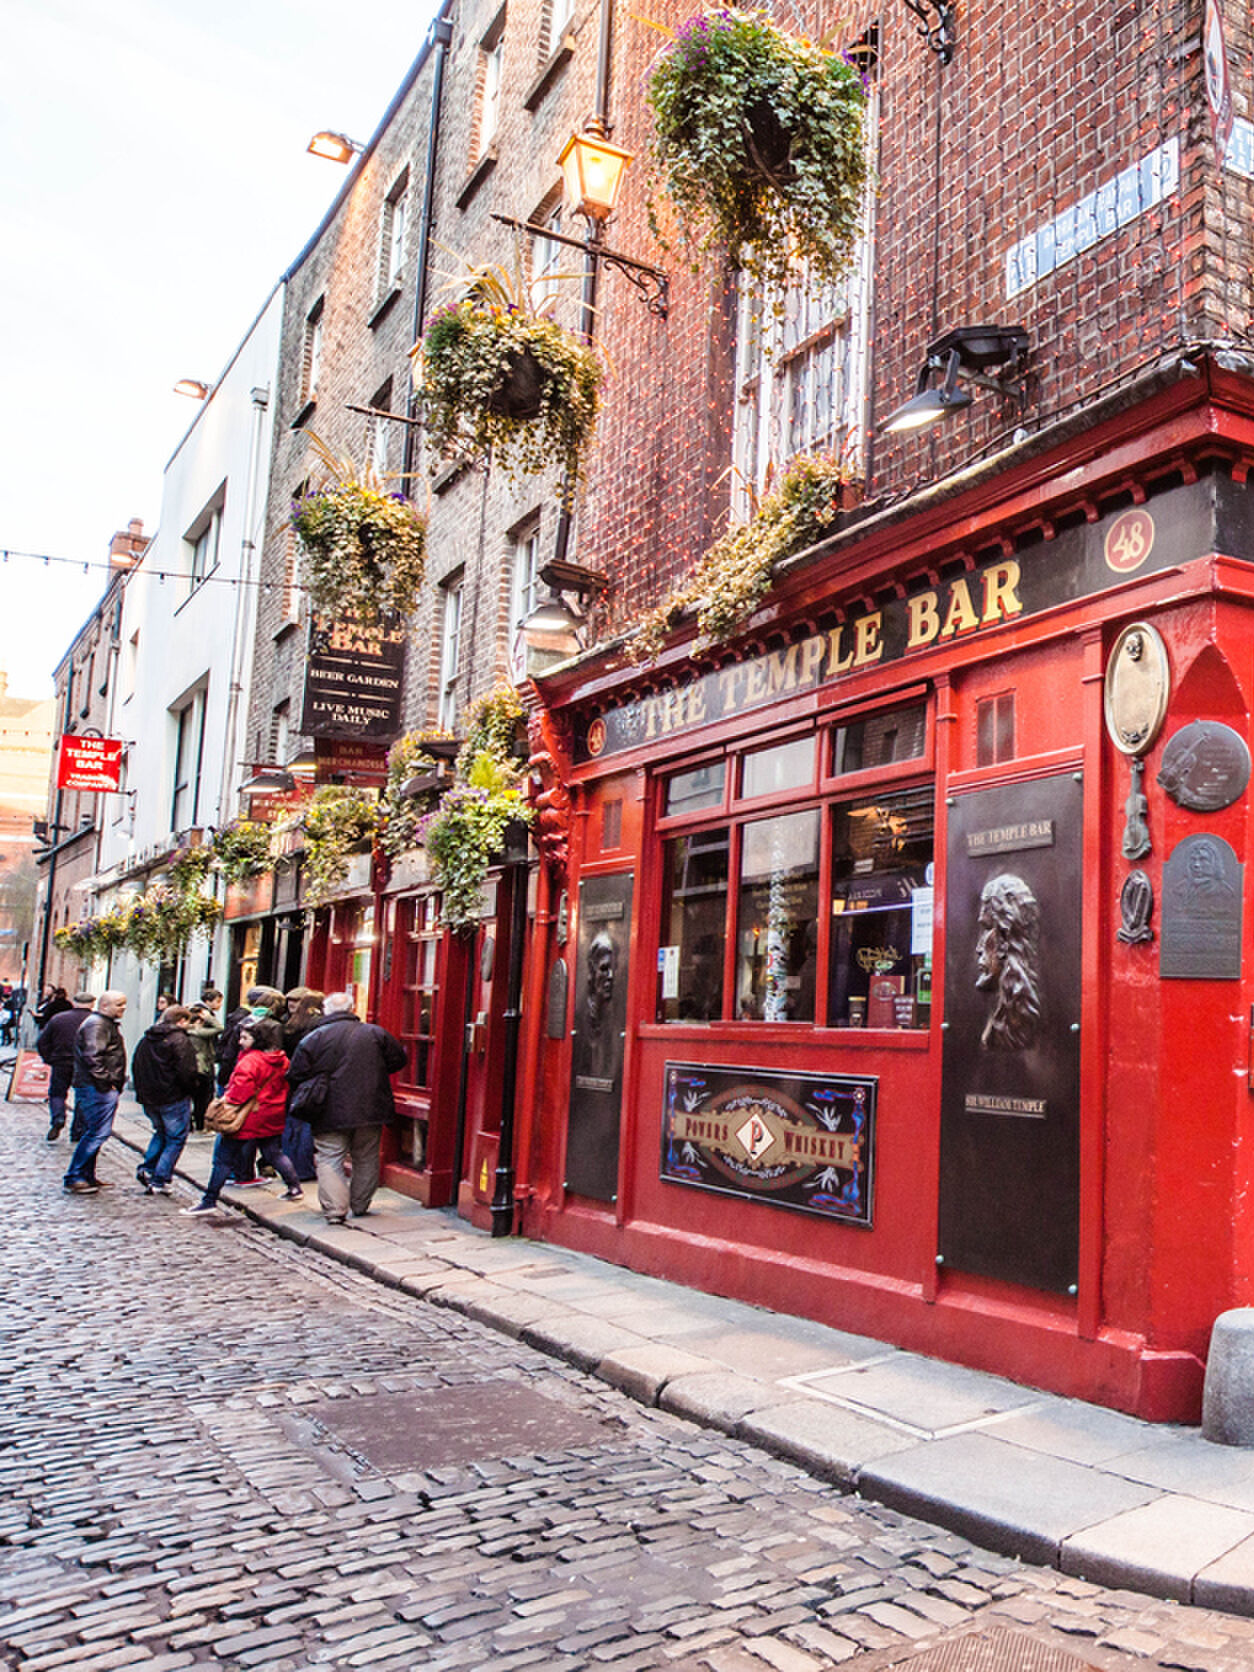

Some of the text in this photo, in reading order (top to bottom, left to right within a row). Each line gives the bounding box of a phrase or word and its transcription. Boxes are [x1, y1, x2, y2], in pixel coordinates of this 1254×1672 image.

[1112, 521, 1146, 563] 48
[329, 631, 384, 657] BAR
[641, 560, 1023, 738] THE TEMPLE BAR
[310, 668, 400, 690] BEER GARDEN
[312, 701, 391, 720] LIVE MUSIC
[331, 713, 373, 726] DAILY
[66, 747, 119, 762] TEMPLE
[81, 740, 105, 750] THE
[75, 760, 104, 771] BAR
[987, 823, 1027, 845] TEMPLE
[1029, 820, 1052, 837] BAR
[685, 1117, 846, 1160] POWERS P WHISKEY
